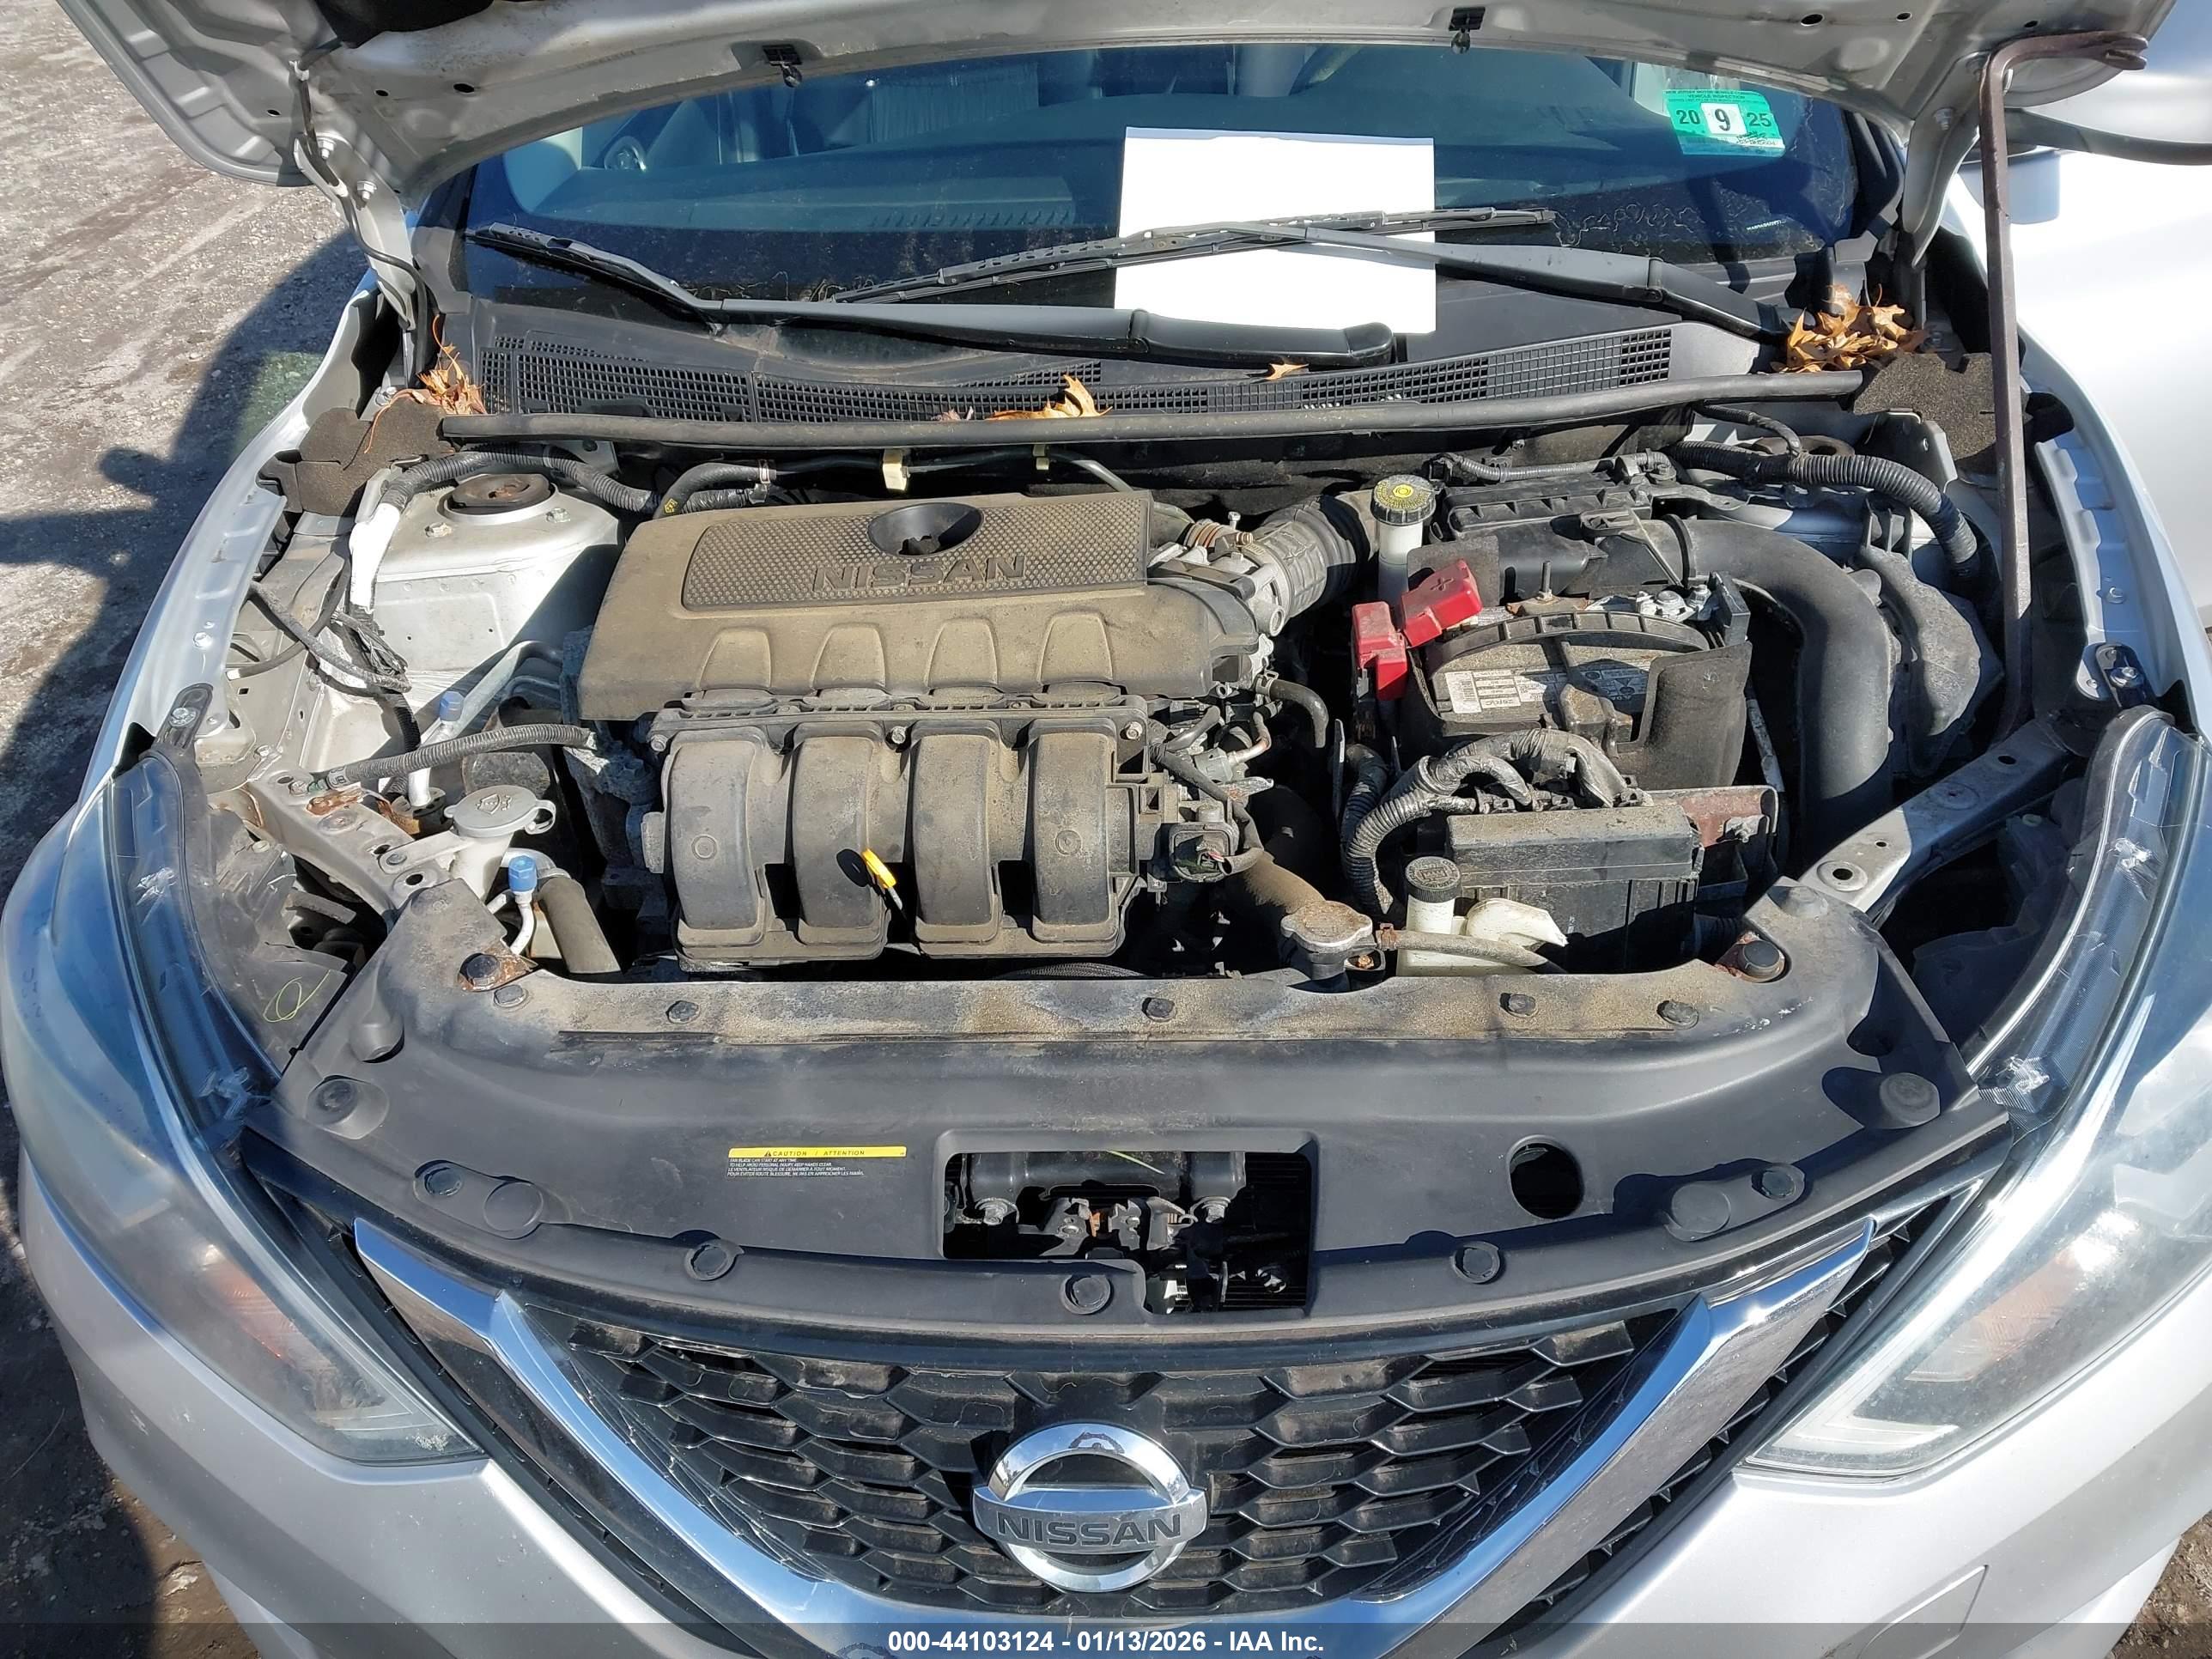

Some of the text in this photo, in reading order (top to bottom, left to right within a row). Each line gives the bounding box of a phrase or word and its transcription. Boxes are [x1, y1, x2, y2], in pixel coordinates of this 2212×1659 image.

[1676, 108, 1771, 131] 20 9 25
[812, 554, 1026, 592] NISSAN
[996, 1511, 1182, 1547] NISSAN
